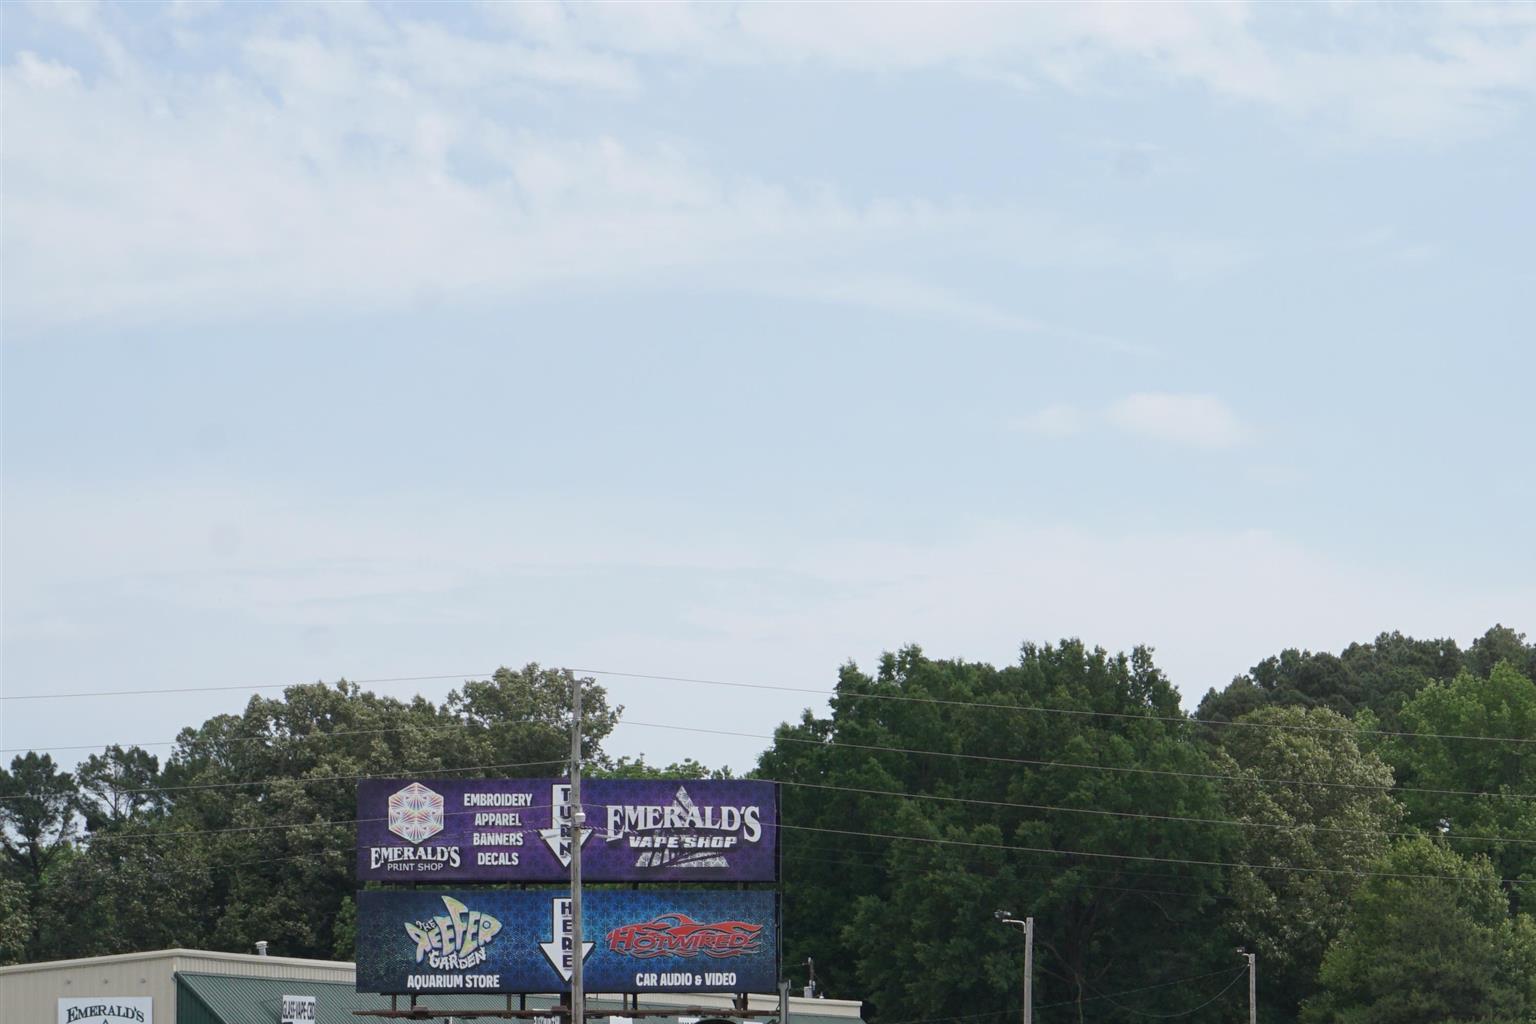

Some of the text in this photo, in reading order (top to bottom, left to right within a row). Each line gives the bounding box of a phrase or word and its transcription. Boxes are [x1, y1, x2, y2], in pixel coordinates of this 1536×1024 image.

[464, 793, 533, 807] EMBROIDERY
[474, 813, 522, 826] APPAREL
[606, 805, 762, 843] EMERALD'S
[473, 832, 524, 846] BANNERS
[629, 836, 738, 848] VAPE SHOP
[370, 846, 461, 870] EMERALD'S
[477, 852, 519, 865] DECALS
[387, 863, 444, 871] PRINT SHOP
[416, 920, 438, 931] THE
[561, 901, 573, 968] HERE
[607, 927, 751, 951] HOTWIRED
[428, 947, 487, 970] GARDEN
[407, 974, 500, 989] AQUARIUM STORE
[636, 972, 737, 986] CAR AUDIO & VIDEO
[66, 1004, 145, 1024] EMERALD'S
